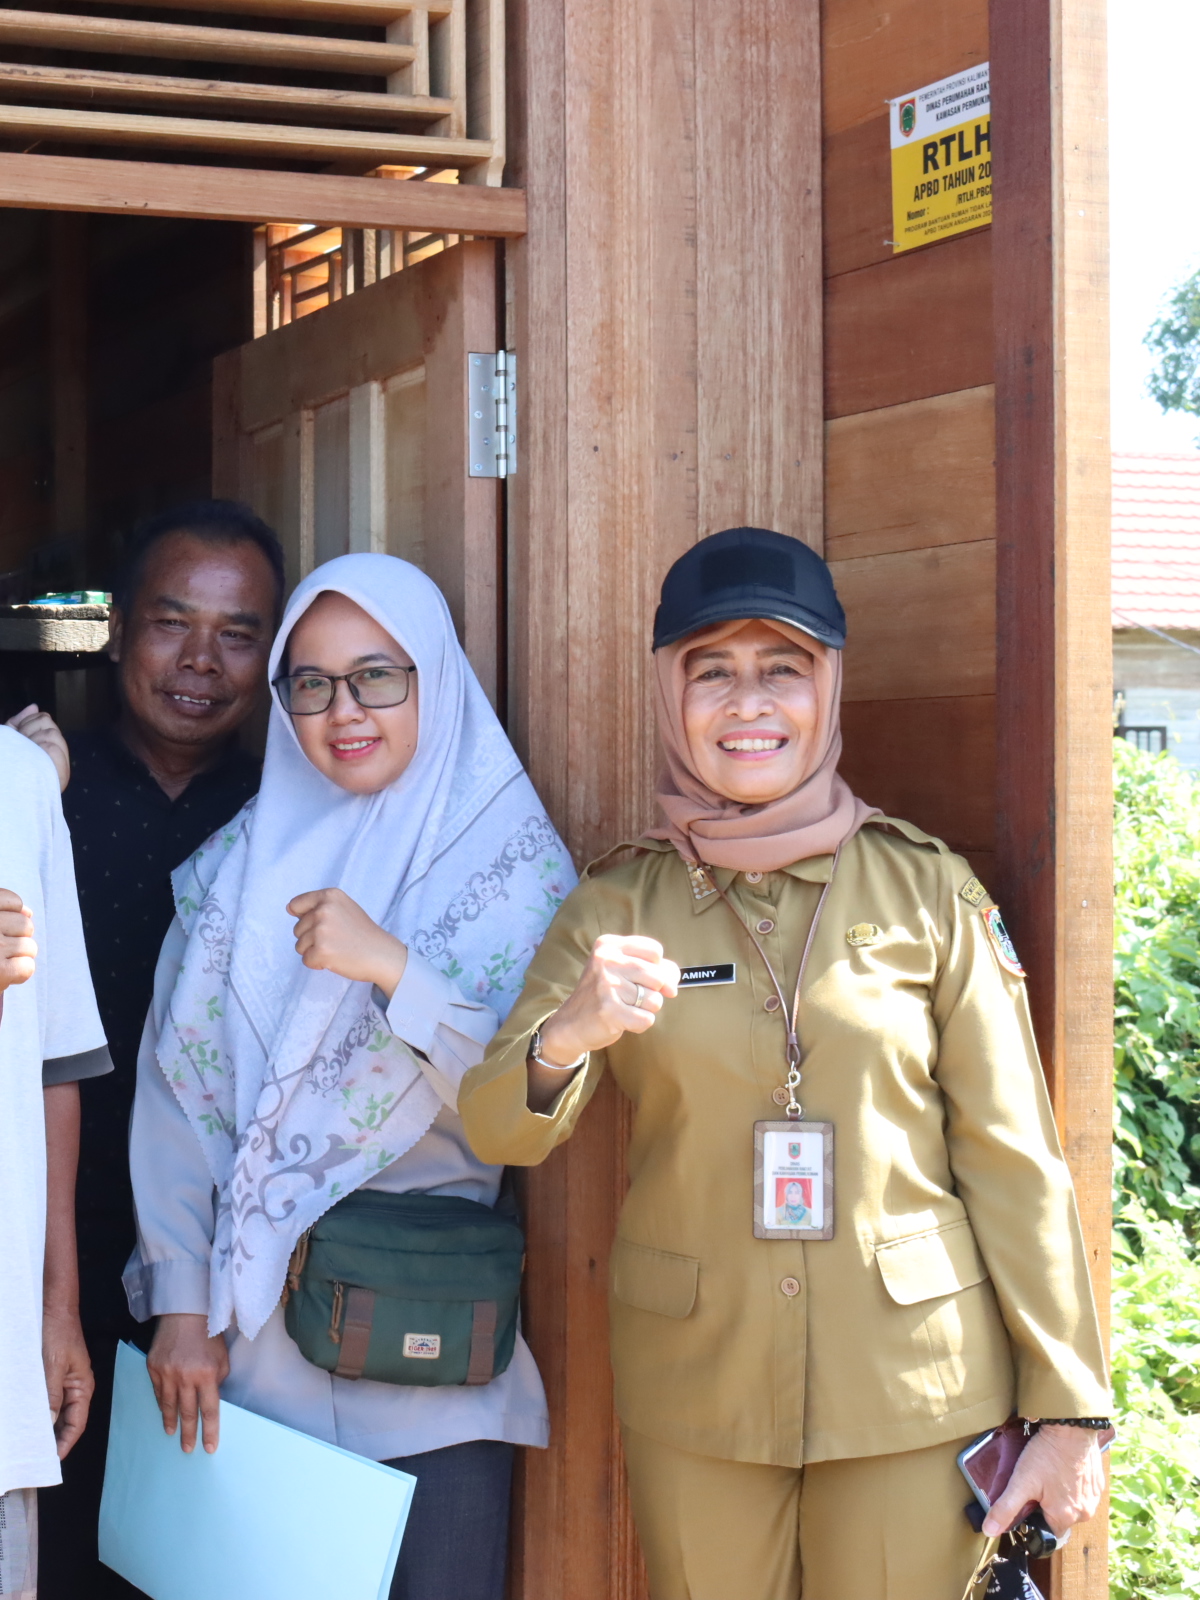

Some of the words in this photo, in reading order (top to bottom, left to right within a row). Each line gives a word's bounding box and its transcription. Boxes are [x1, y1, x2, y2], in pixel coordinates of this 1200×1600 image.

[926, 100, 941, 113] DINAS
[942, 86, 975, 106] PERUMAHAN
[936, 105, 961, 122] KAWASAN
[923, 121, 991, 175] RTLH
[914, 178, 939, 202] APBD
[942, 166, 975, 192] TAHUN
[905, 221, 928, 233] PROGRAM
[928, 214, 950, 226] BANTUAN
[951, 208, 969, 218] RUMAH
[969, 202, 985, 213] TIDAK
[682, 970, 716, 980] AMINY
